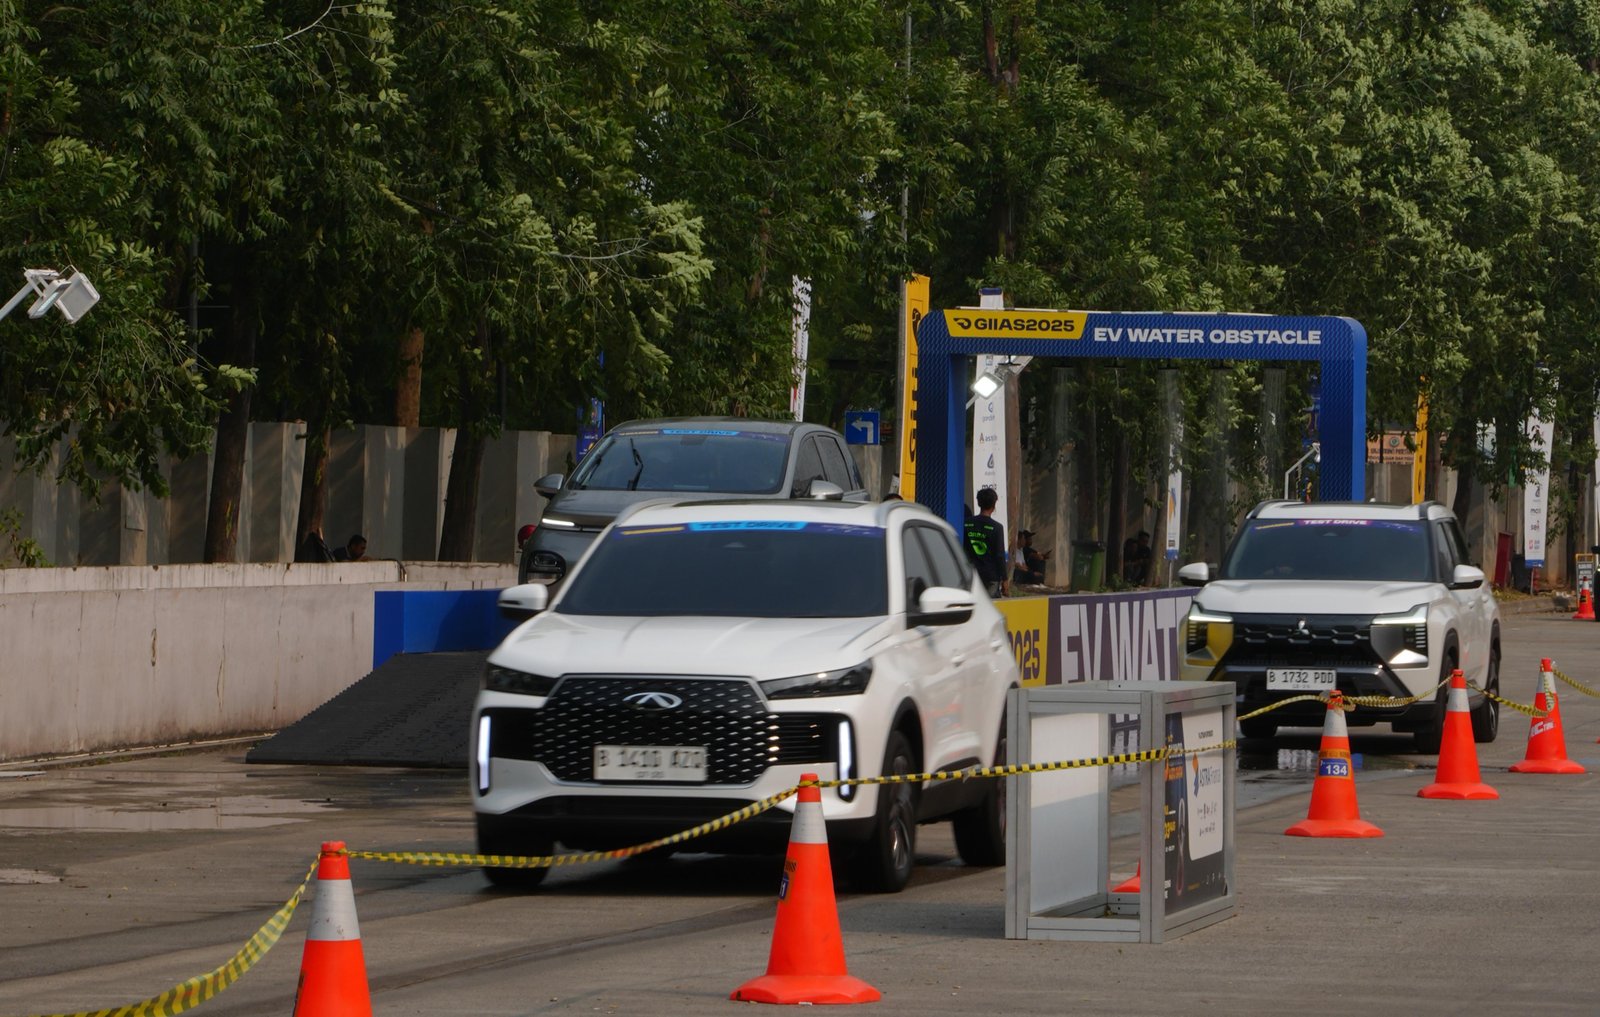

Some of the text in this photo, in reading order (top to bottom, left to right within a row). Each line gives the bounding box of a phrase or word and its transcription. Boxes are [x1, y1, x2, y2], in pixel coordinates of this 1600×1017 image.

[974, 318, 1075, 332] GIIAS2025
[1094, 327, 1322, 344] EV WATER OBSTACLE
[699, 521, 797, 530] TEST DRIVE
[1269, 672, 1276, 683] B
[1282, 671, 1309, 683] 1732
[1326, 764, 1347, 776] 134
